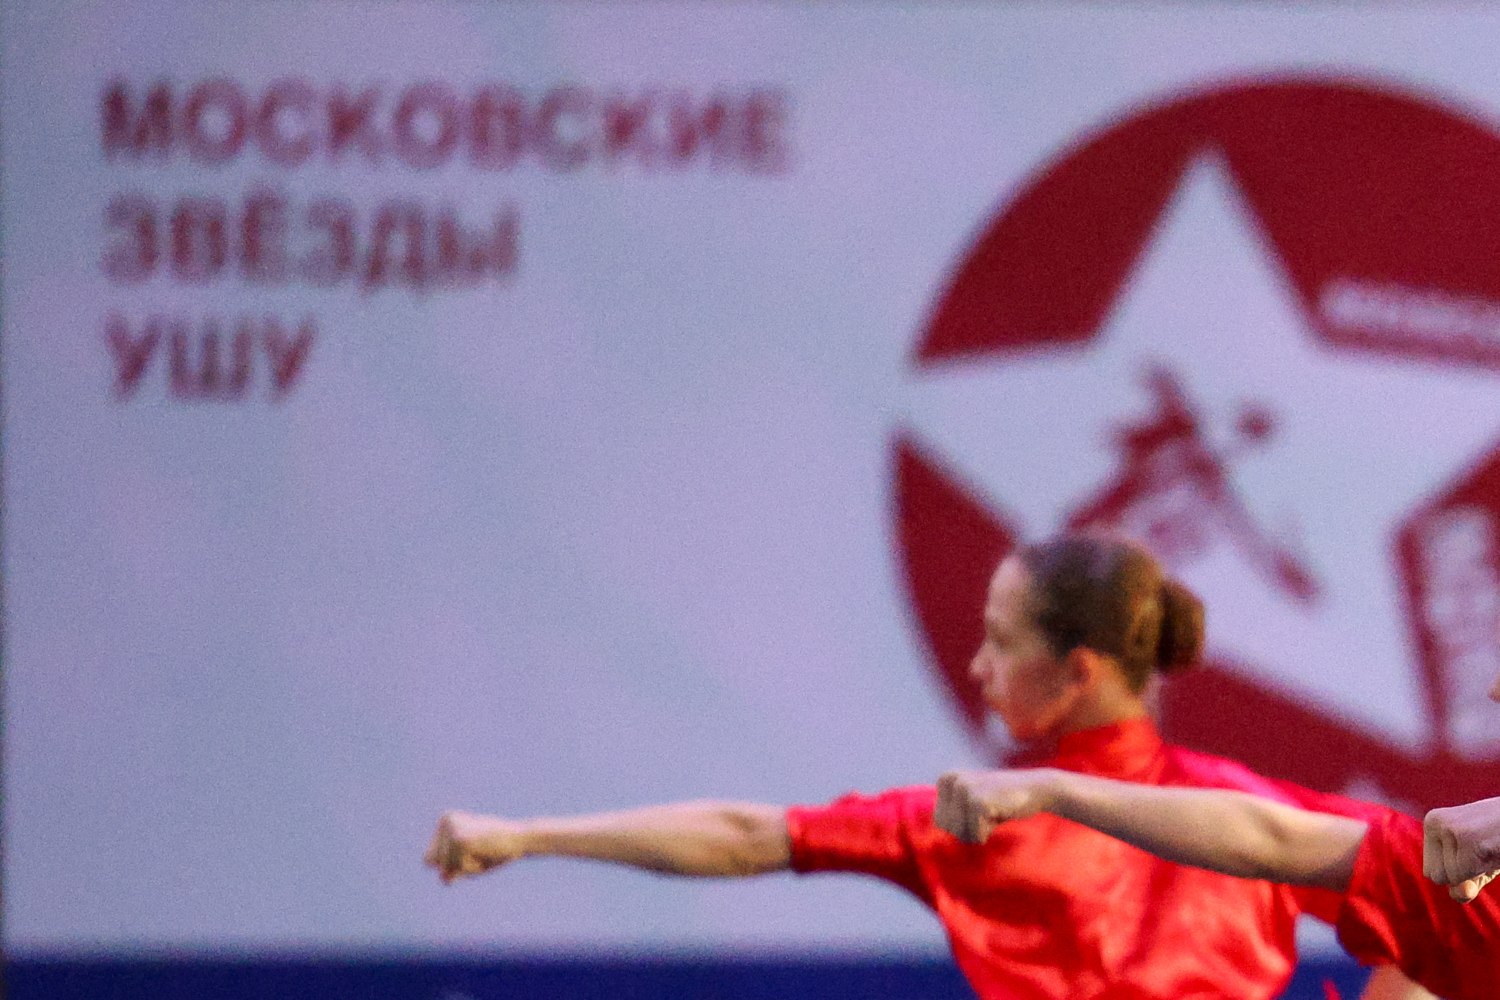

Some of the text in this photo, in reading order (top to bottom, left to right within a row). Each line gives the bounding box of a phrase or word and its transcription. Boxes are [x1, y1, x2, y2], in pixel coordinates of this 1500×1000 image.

[101, 79, 789, 173] МОСКОВСКИЕ
[102, 188, 521, 295] ЗВЁЗДЫ
[105, 317, 315, 399] УШУ
